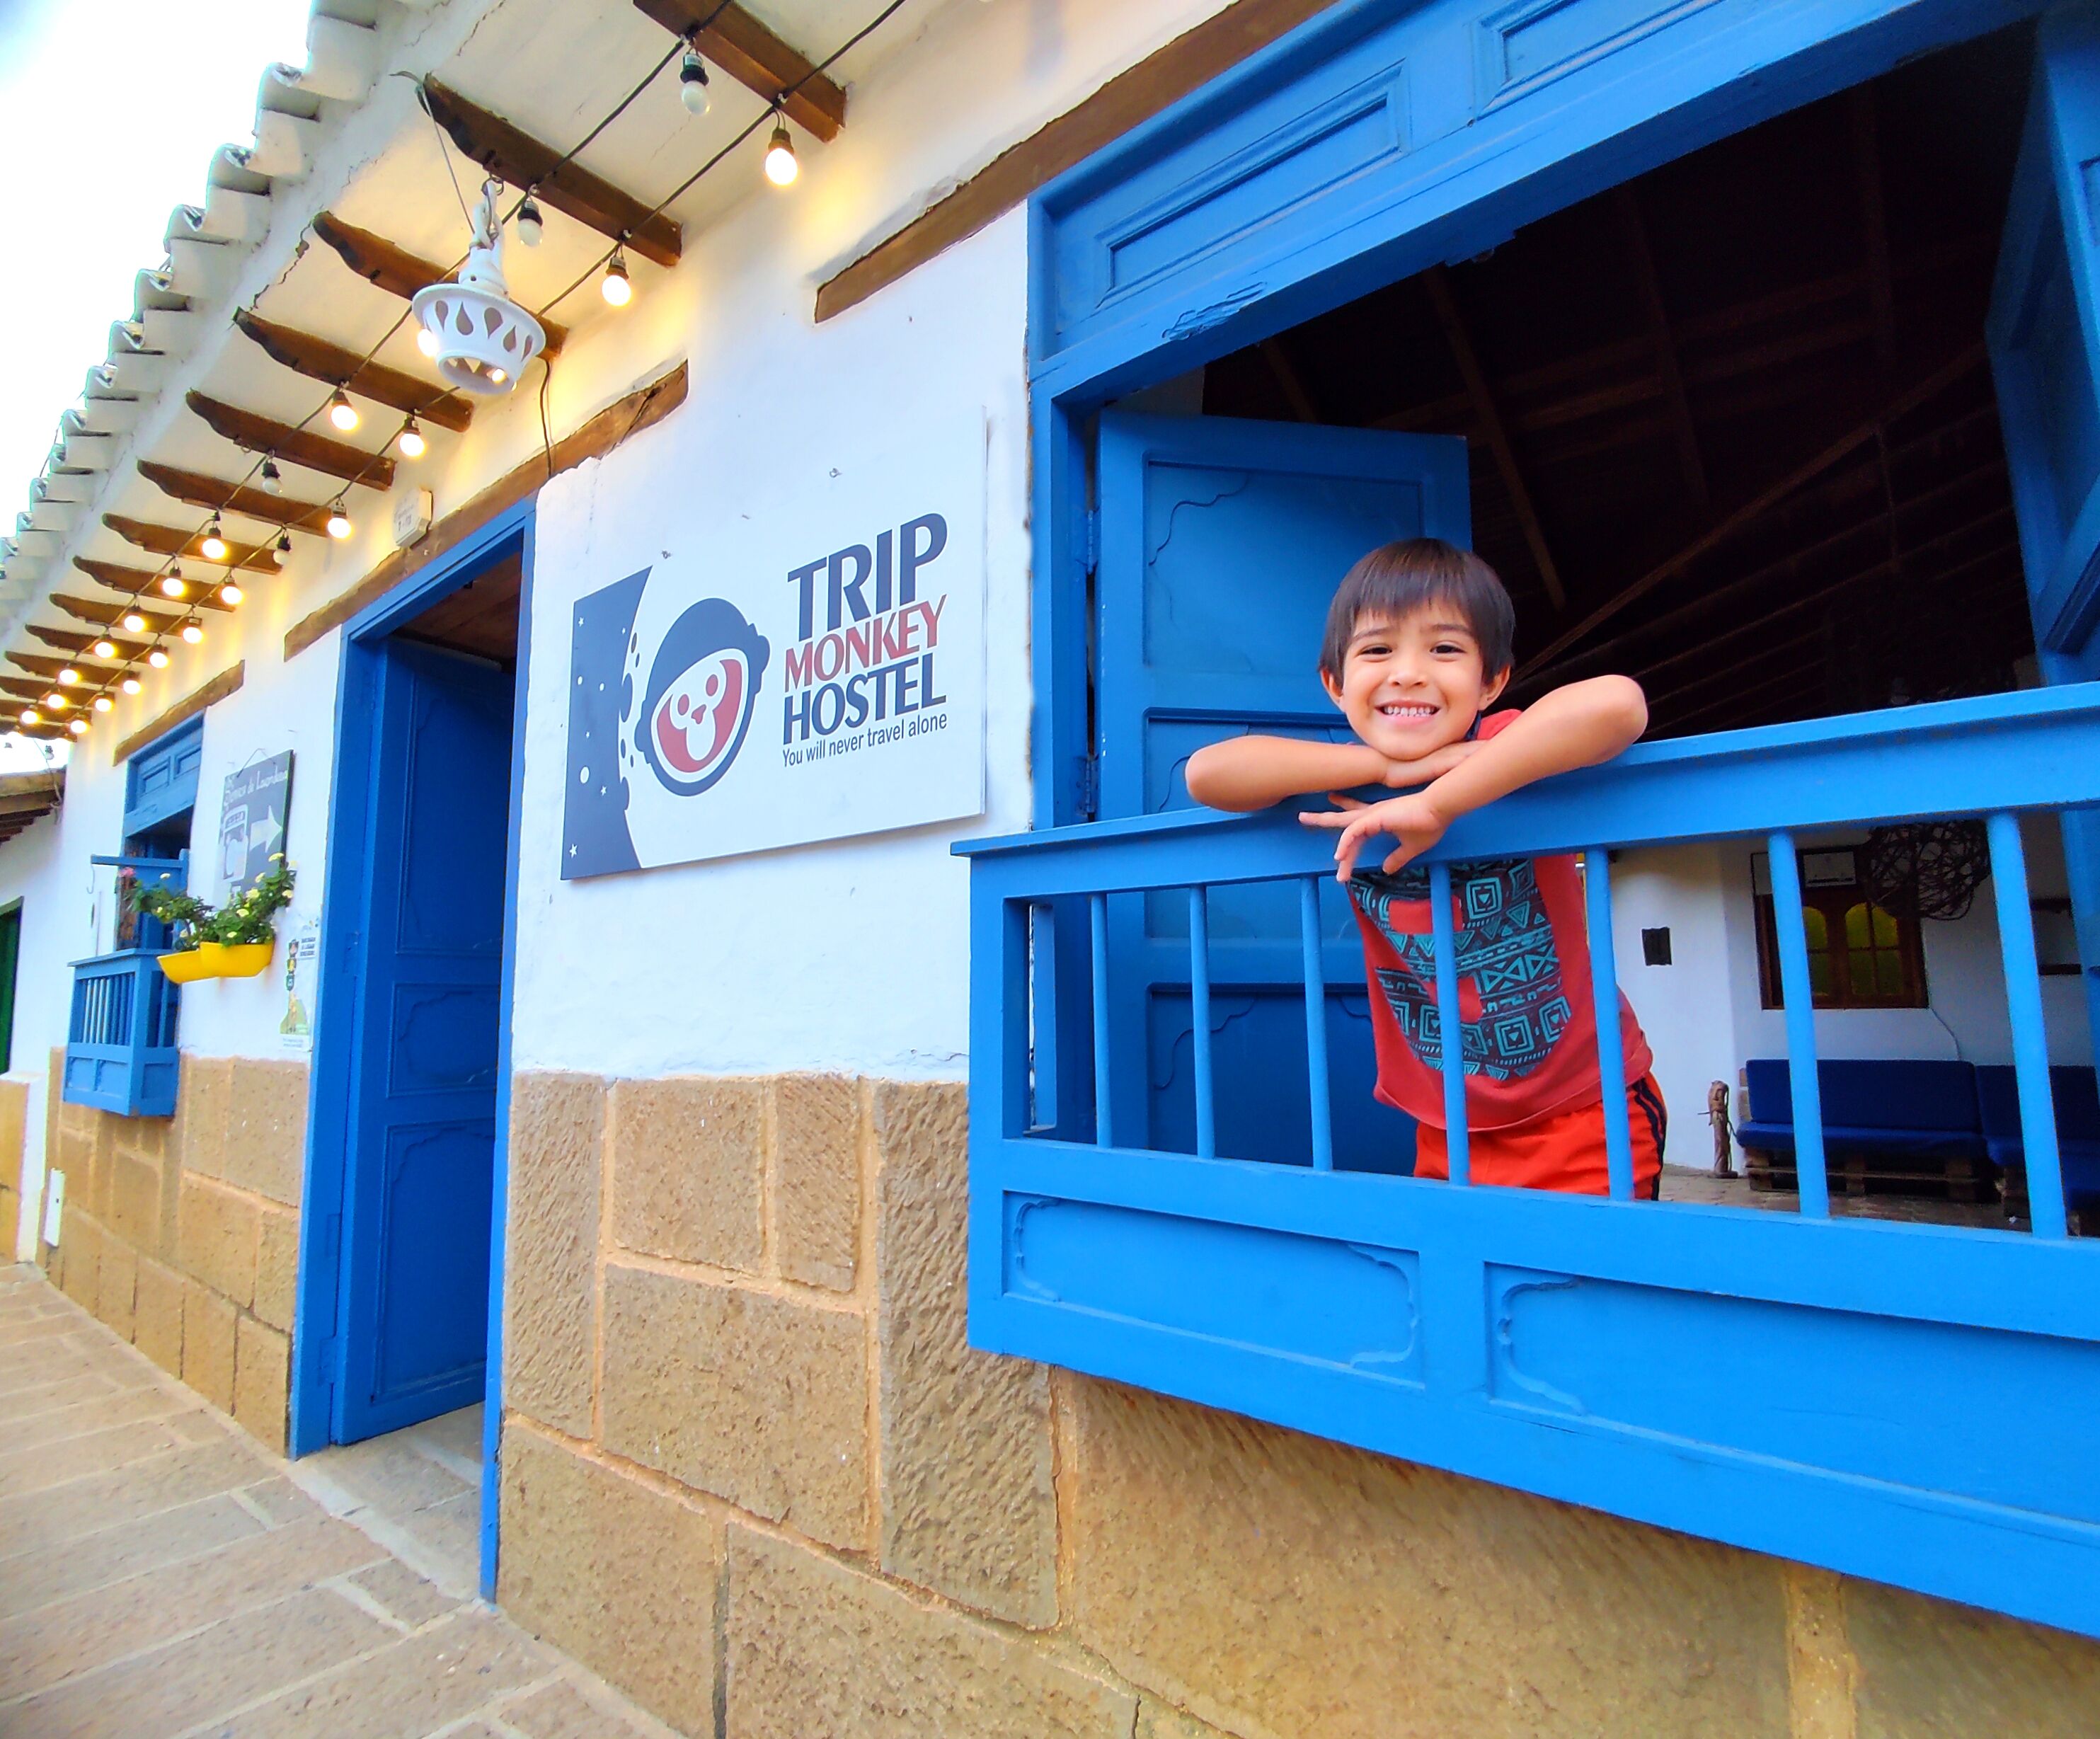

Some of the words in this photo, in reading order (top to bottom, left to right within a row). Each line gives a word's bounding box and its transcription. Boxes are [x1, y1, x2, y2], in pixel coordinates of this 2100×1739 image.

[787, 512, 948, 642] TRIP
[784, 594, 947, 693] MONKEY
[782, 747, 803, 767] You
[805, 738, 826, 762] will
[828, 734, 865, 757] never
[867, 718, 905, 747] travel
[907, 713, 948, 738] alone
[783, 652, 947, 745] HOSTEL
